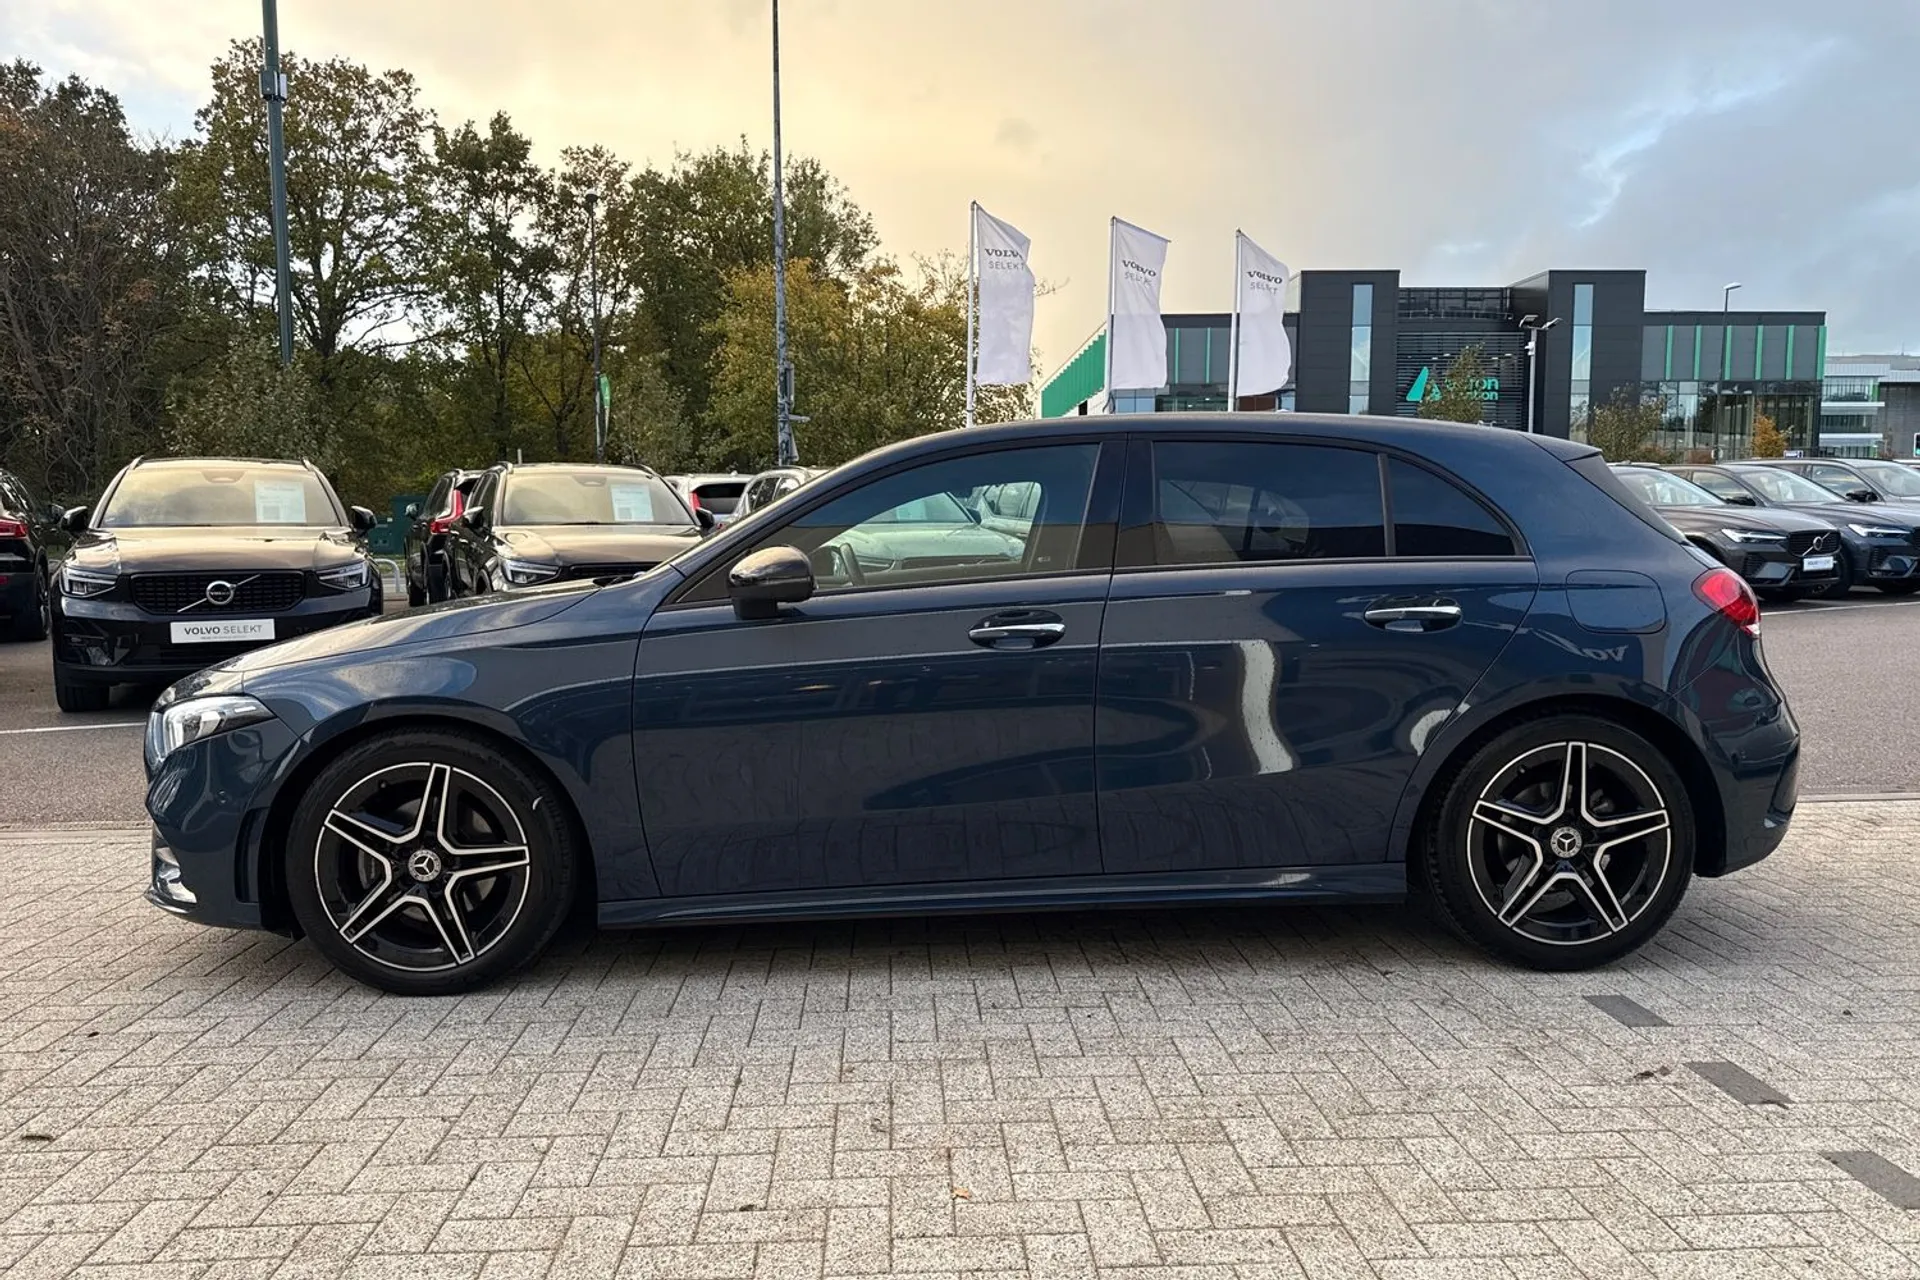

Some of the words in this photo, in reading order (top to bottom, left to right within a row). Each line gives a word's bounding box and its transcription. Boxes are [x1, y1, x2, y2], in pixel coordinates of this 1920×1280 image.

[984, 248, 1023, 260] VOLV
[1122, 260, 1156, 277] VOLVO
[1246, 270, 1282, 284] VOLVO
[184, 626, 221, 635] VOLVO
[223, 624, 262, 634] SELEKT
